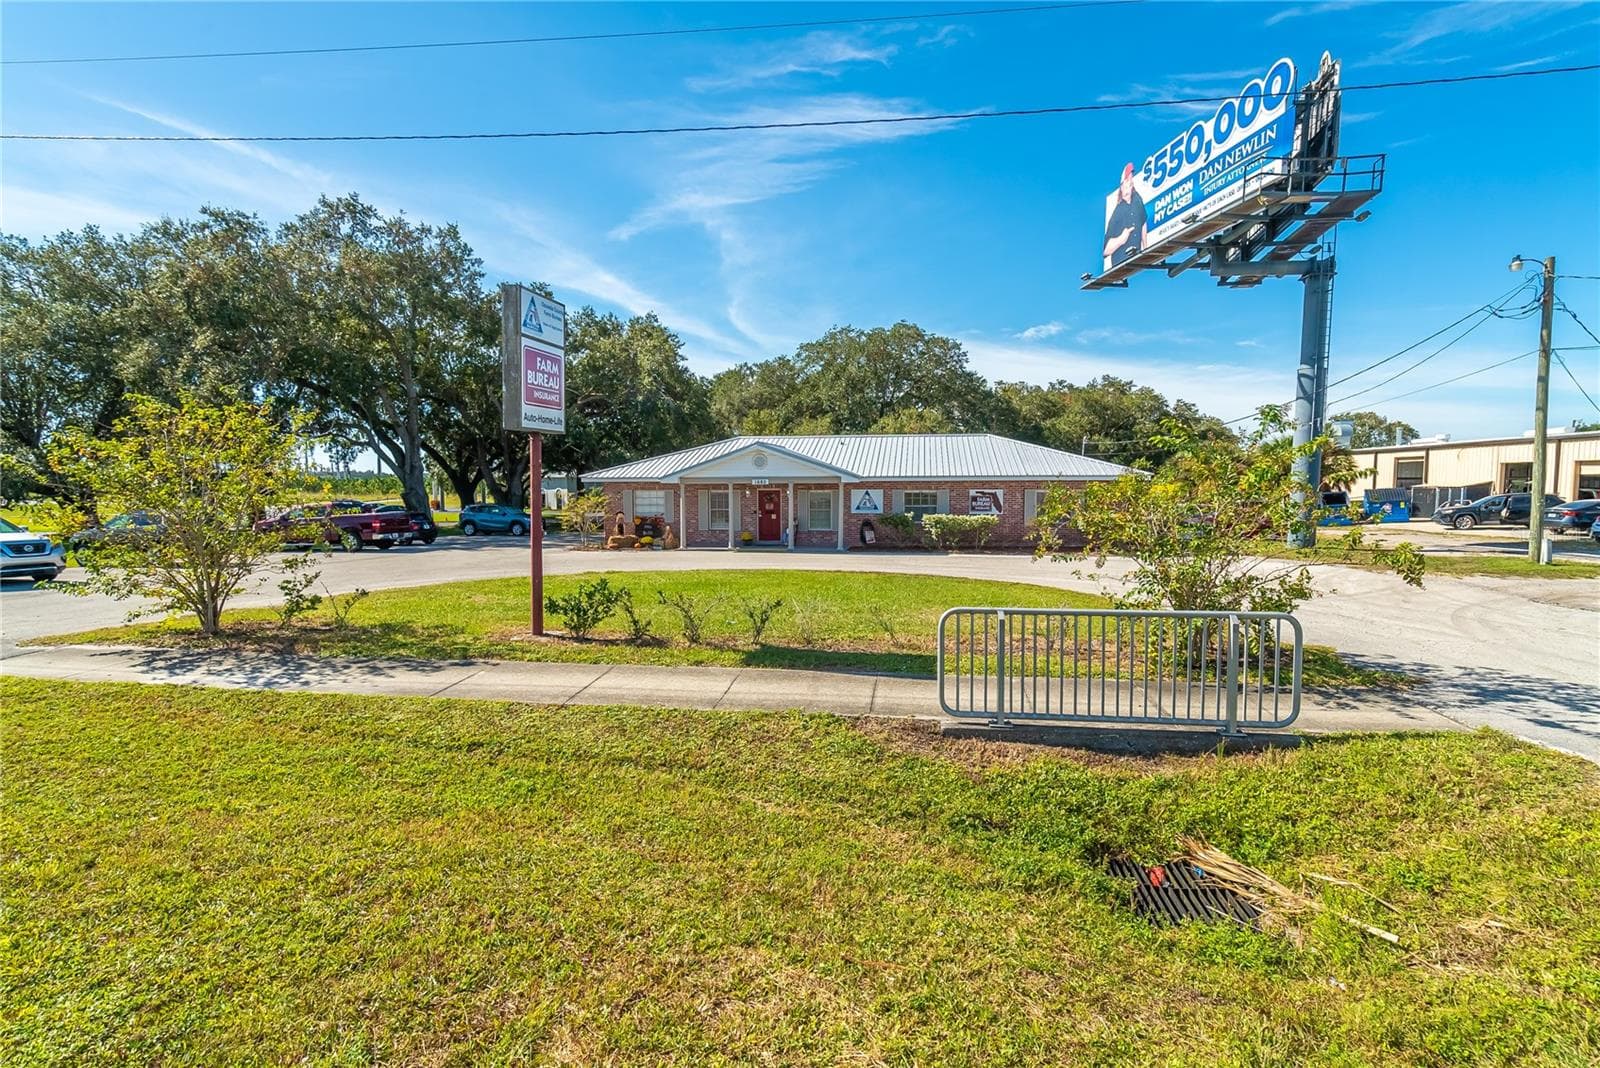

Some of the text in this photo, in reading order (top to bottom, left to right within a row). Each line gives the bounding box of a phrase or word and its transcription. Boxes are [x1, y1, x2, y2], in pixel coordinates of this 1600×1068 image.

[1142, 61, 1291, 188] $550,000
[1198, 157, 1223, 185] DAN
[1224, 124, 1277, 170] NEWLIN
[1154, 192, 1171, 211] DAN
[1172, 178, 1193, 202] WON
[1153, 207, 1167, 224] MY
[536, 357, 559, 375] FARM
[527, 370, 560, 389] BUREAU
[533, 389, 560, 403] INSURANCE
